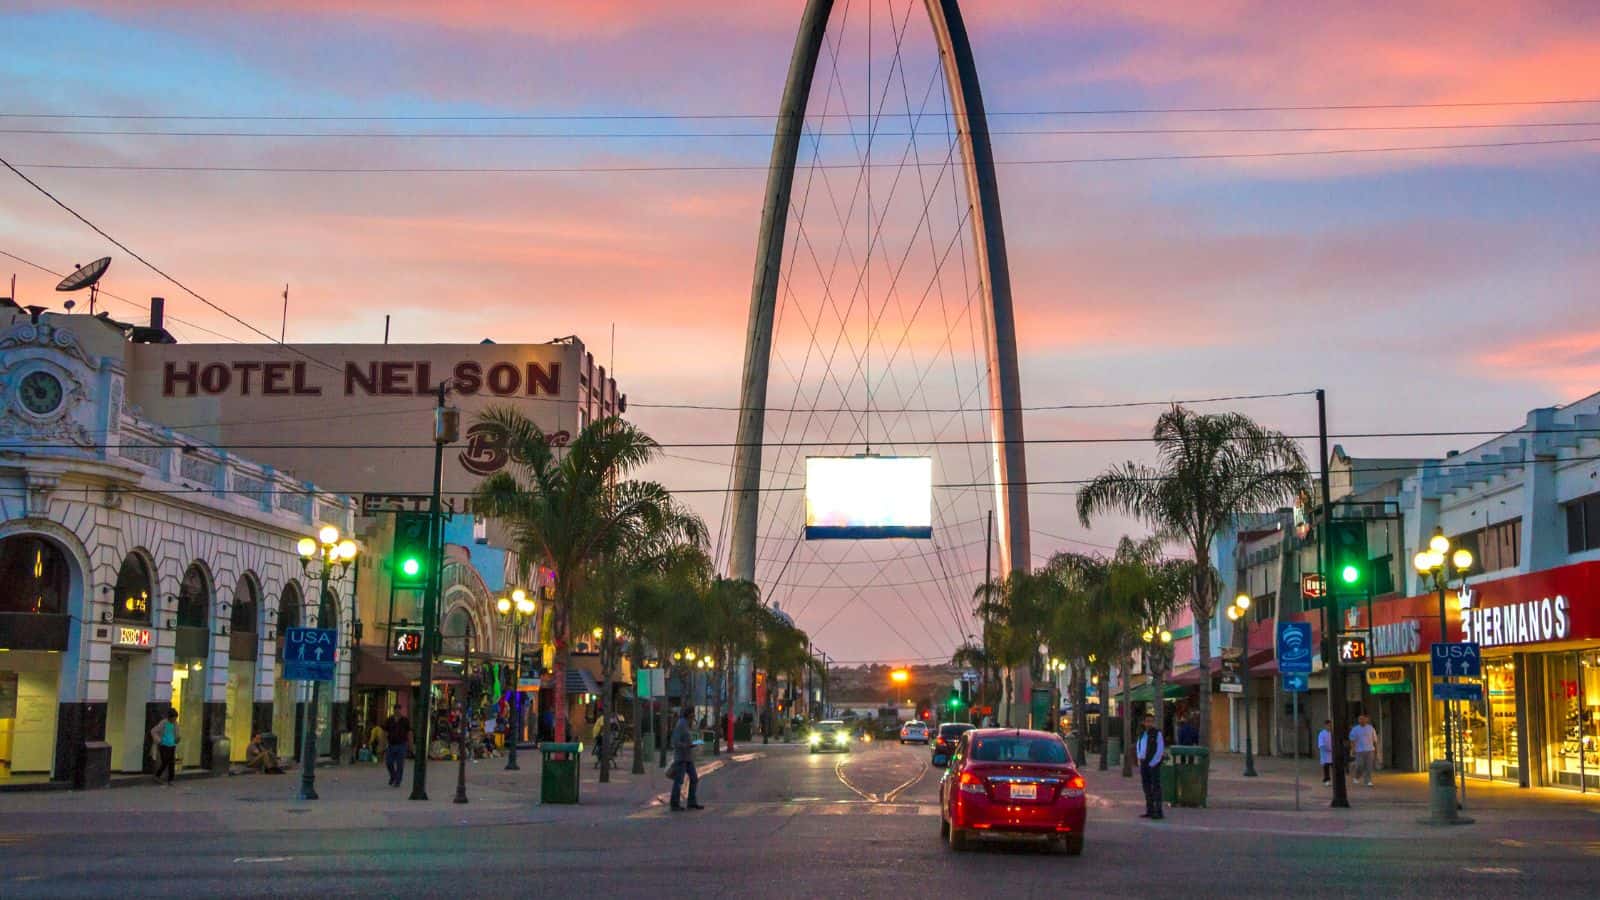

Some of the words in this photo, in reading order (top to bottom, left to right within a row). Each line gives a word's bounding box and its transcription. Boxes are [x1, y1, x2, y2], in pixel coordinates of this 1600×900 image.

[162, 360, 322, 397] HOTEL
[344, 360, 561, 396] NELSON
[1473, 595, 1569, 646] HERMANOS
[291, 631, 330, 645] USA
[1352, 641, 1365, 658] 21
[1436, 645, 1476, 658] USA
